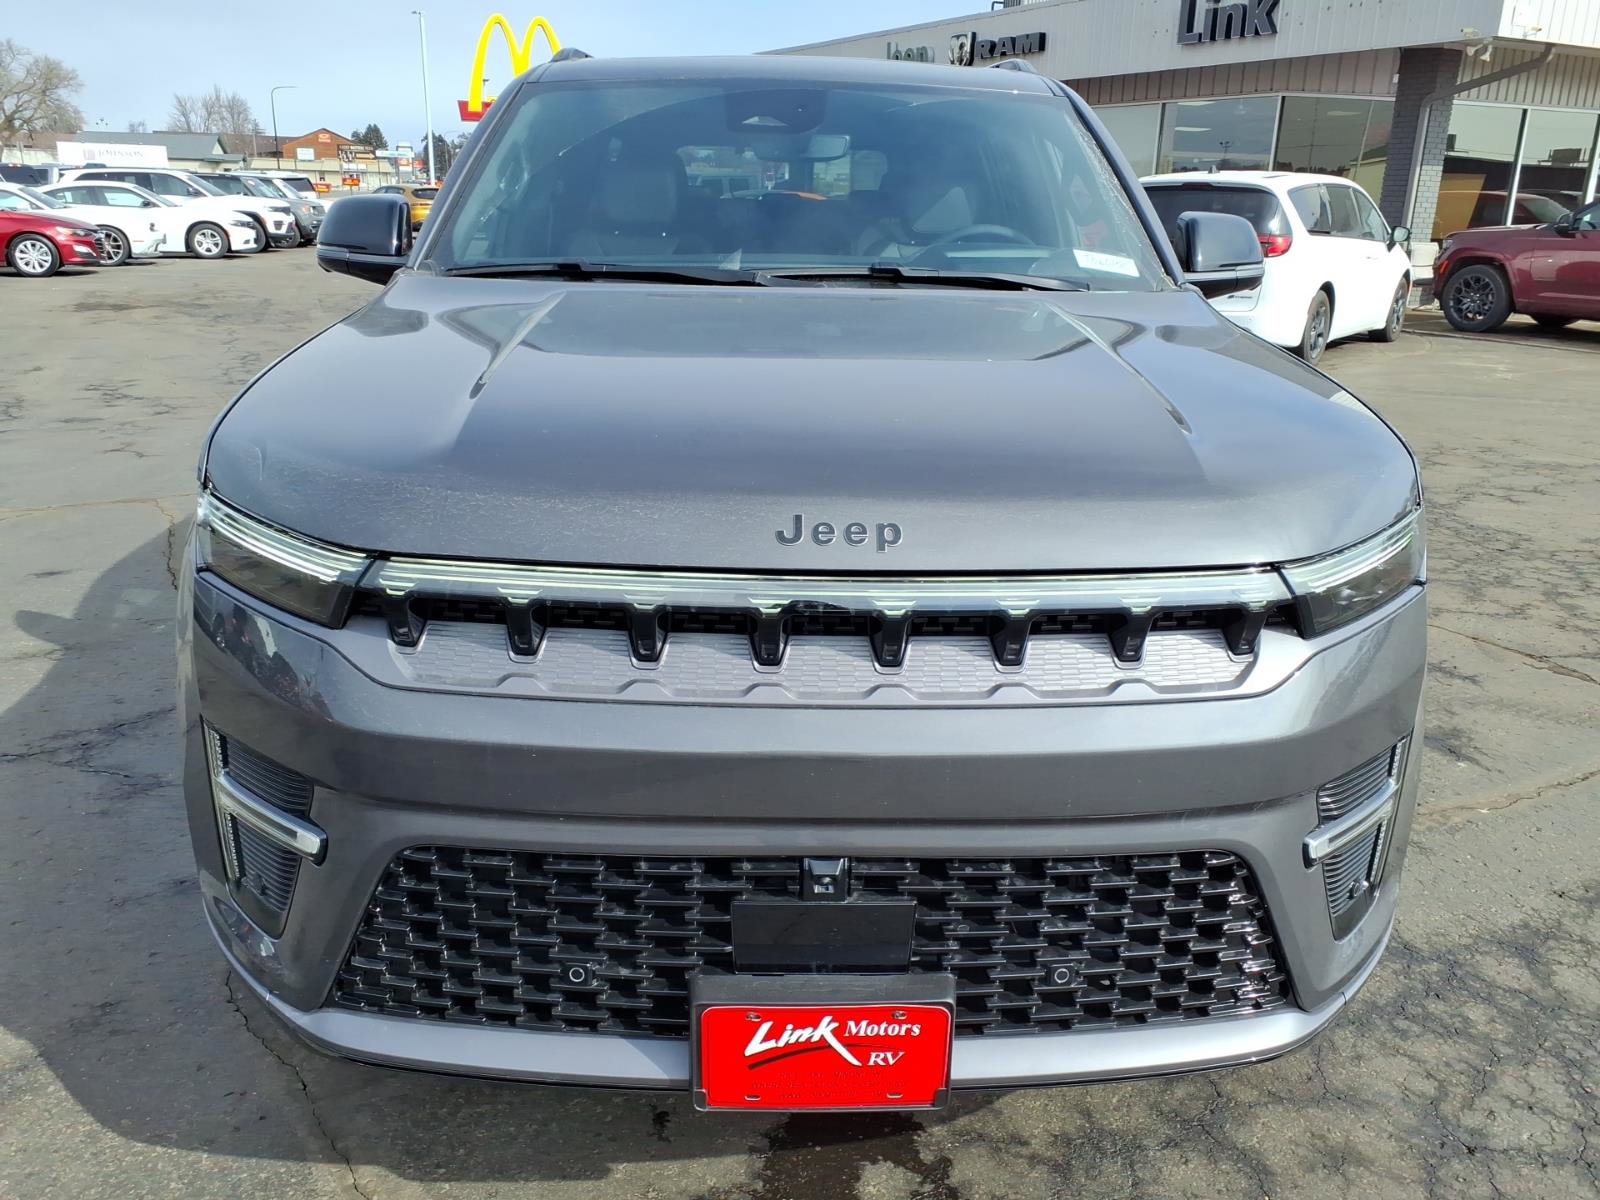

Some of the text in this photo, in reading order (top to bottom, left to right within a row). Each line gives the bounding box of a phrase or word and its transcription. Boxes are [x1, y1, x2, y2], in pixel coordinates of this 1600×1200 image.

[1177, 0, 1278, 45] Link
[975, 32, 1046, 59] RAM
[775, 514, 903, 553] Jeep
[744, 1016, 921, 1066] Link Motors
[867, 1051, 905, 1066] RV
